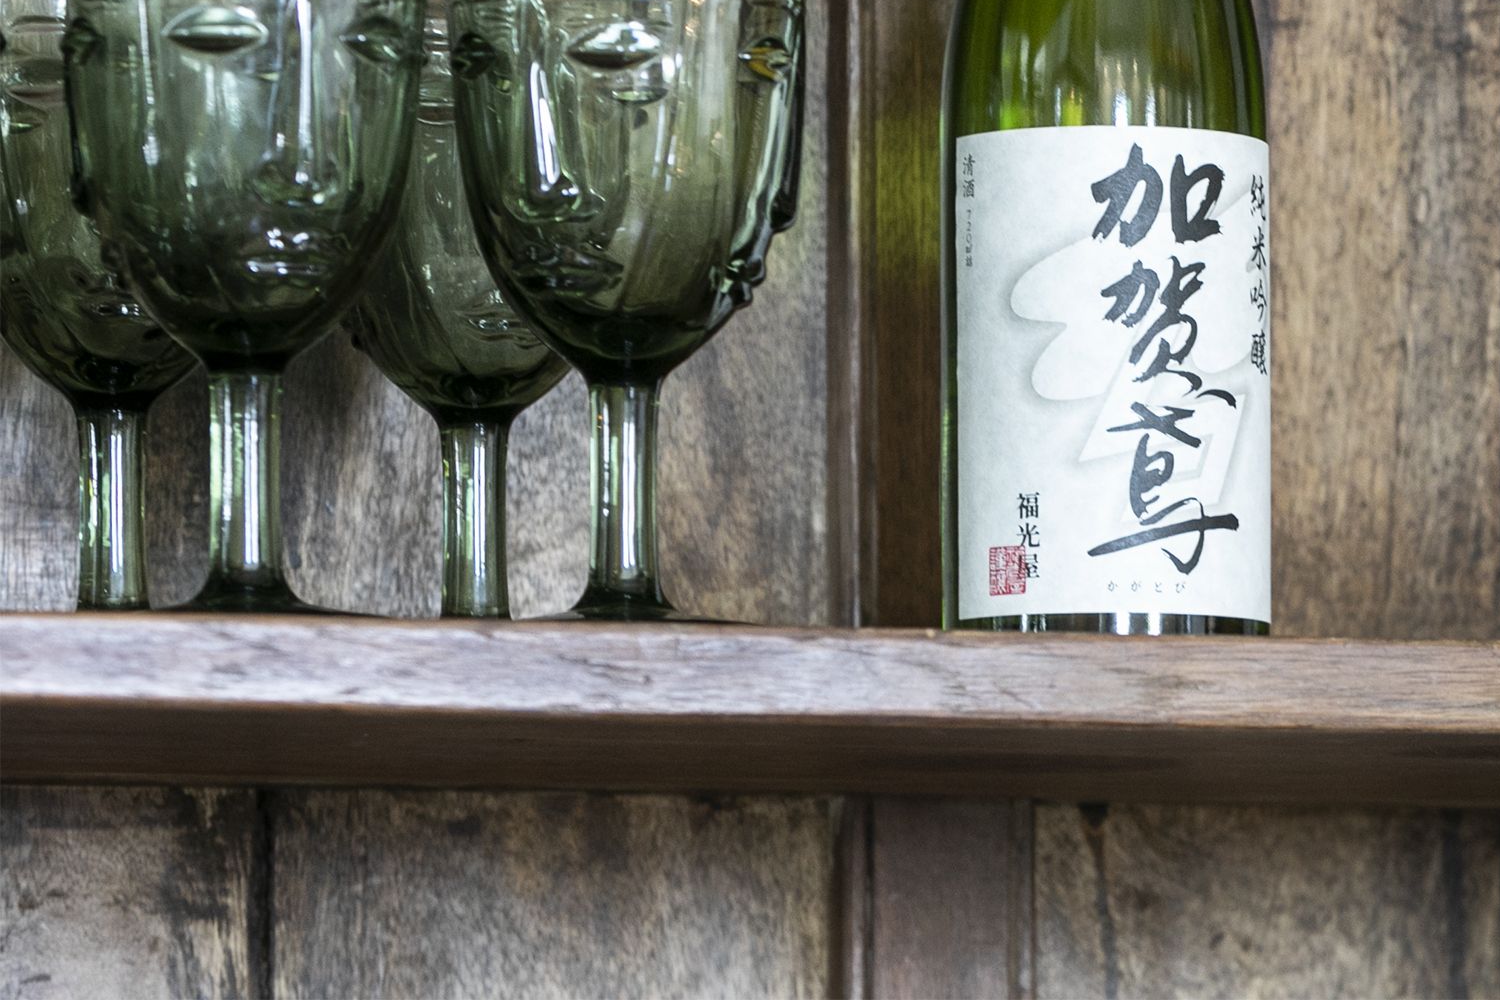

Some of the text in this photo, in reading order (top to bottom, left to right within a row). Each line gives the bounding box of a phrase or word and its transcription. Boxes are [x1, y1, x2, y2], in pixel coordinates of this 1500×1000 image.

[963, 153, 976, 198] 清酒
[1088, 142, 1239, 575] 加賀鳶
[1016, 491, 1041, 579] 福光屋
[1107, 580, 1186, 594] かがとび
